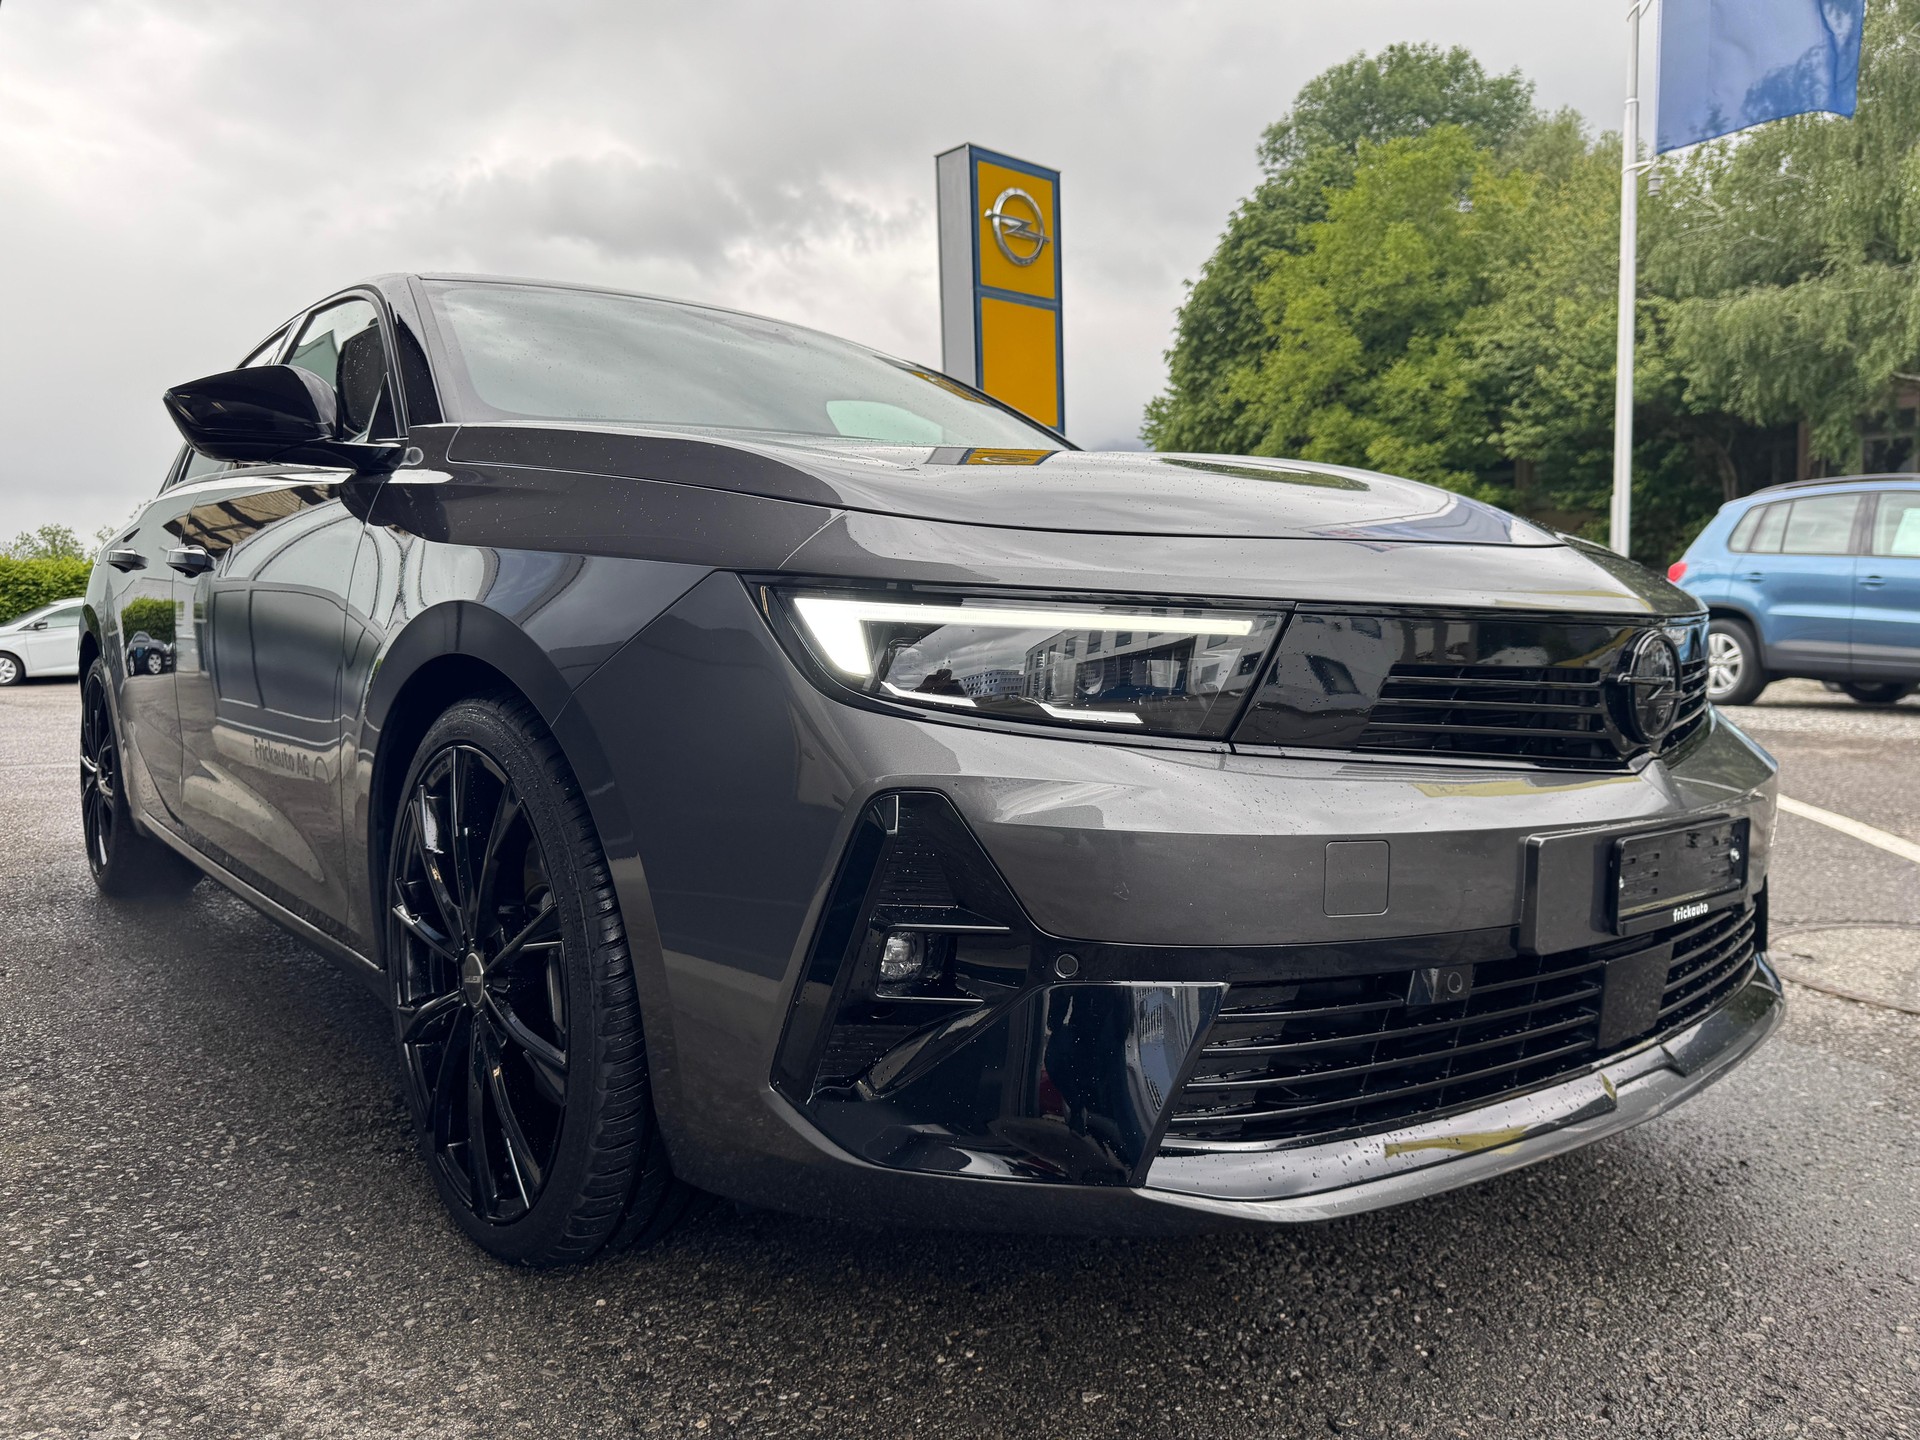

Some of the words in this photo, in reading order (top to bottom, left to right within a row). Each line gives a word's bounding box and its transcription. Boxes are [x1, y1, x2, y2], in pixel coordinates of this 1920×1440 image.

[254, 738, 295, 772] Frickauto
[297, 752, 310, 777] AG
[1673, 902, 1709, 922] frickauto
